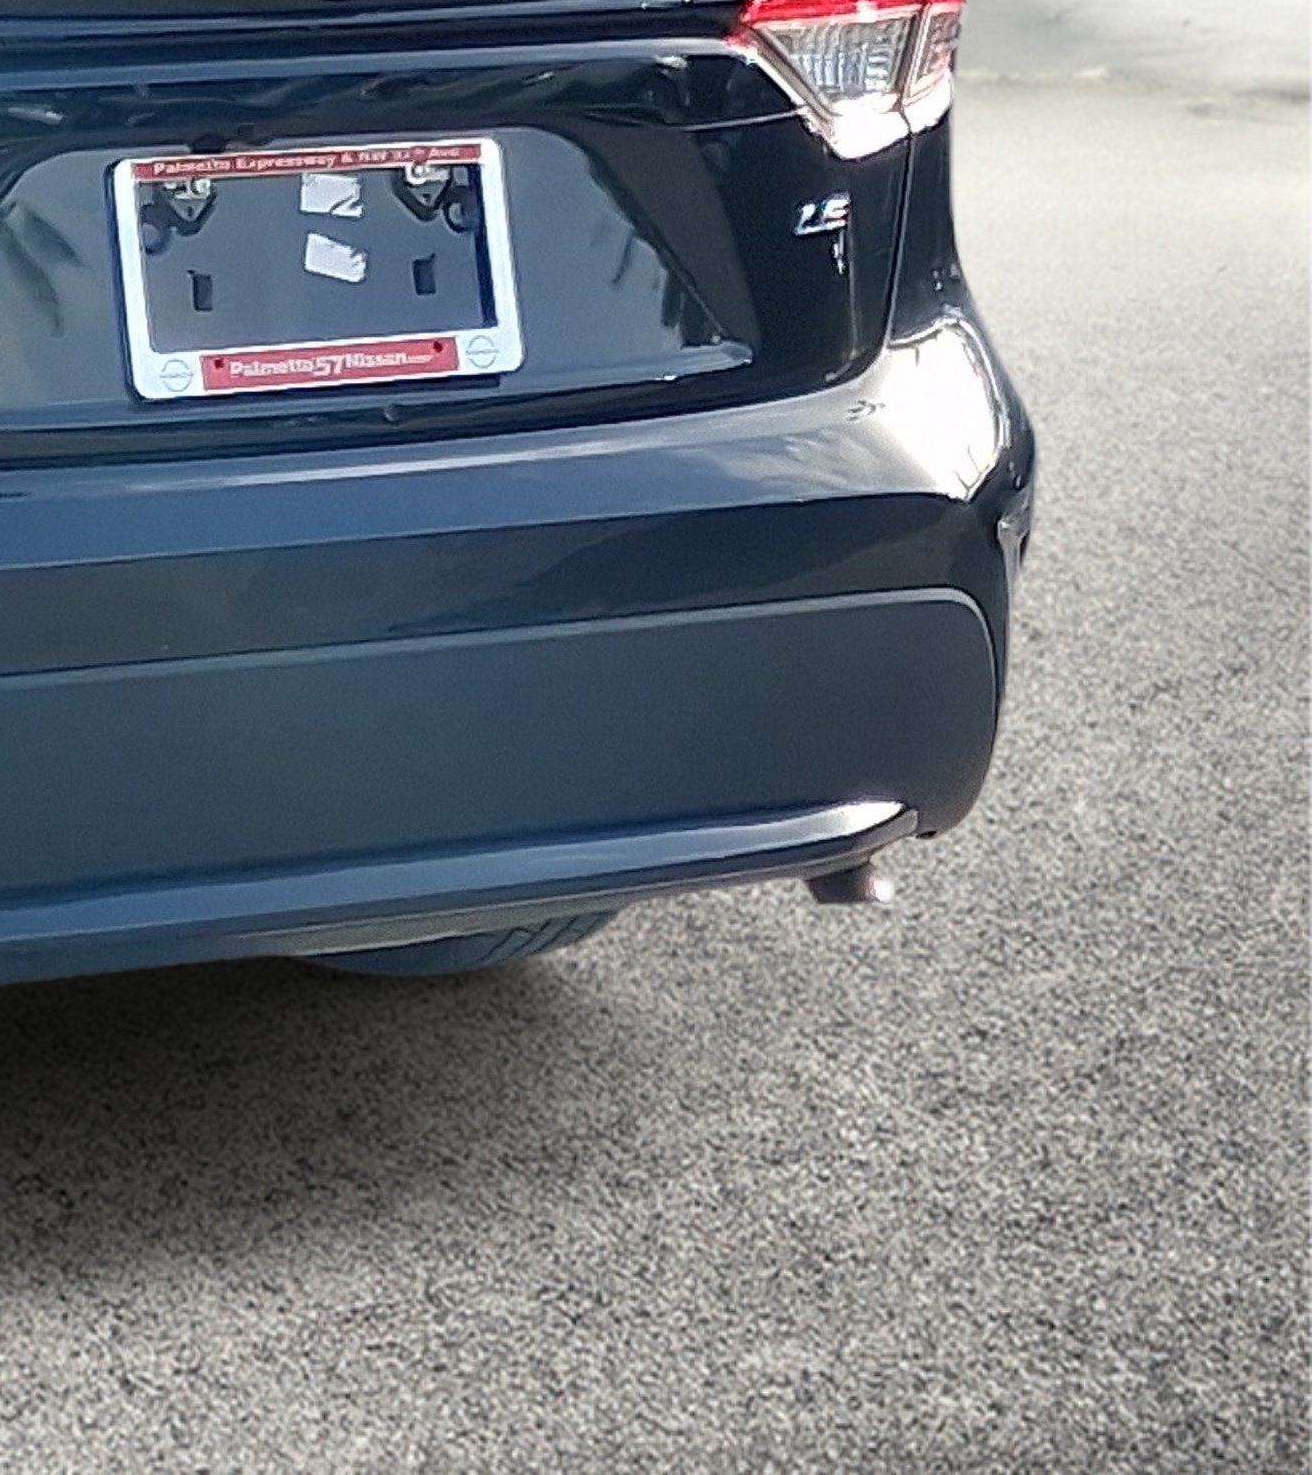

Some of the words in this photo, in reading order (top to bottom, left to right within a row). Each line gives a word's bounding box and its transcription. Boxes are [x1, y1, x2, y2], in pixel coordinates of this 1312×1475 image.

[153, 158, 231, 175] Palmetto
[793, 191, 852, 236] LE
[230, 352, 434, 377] Palmetto57Nissan
